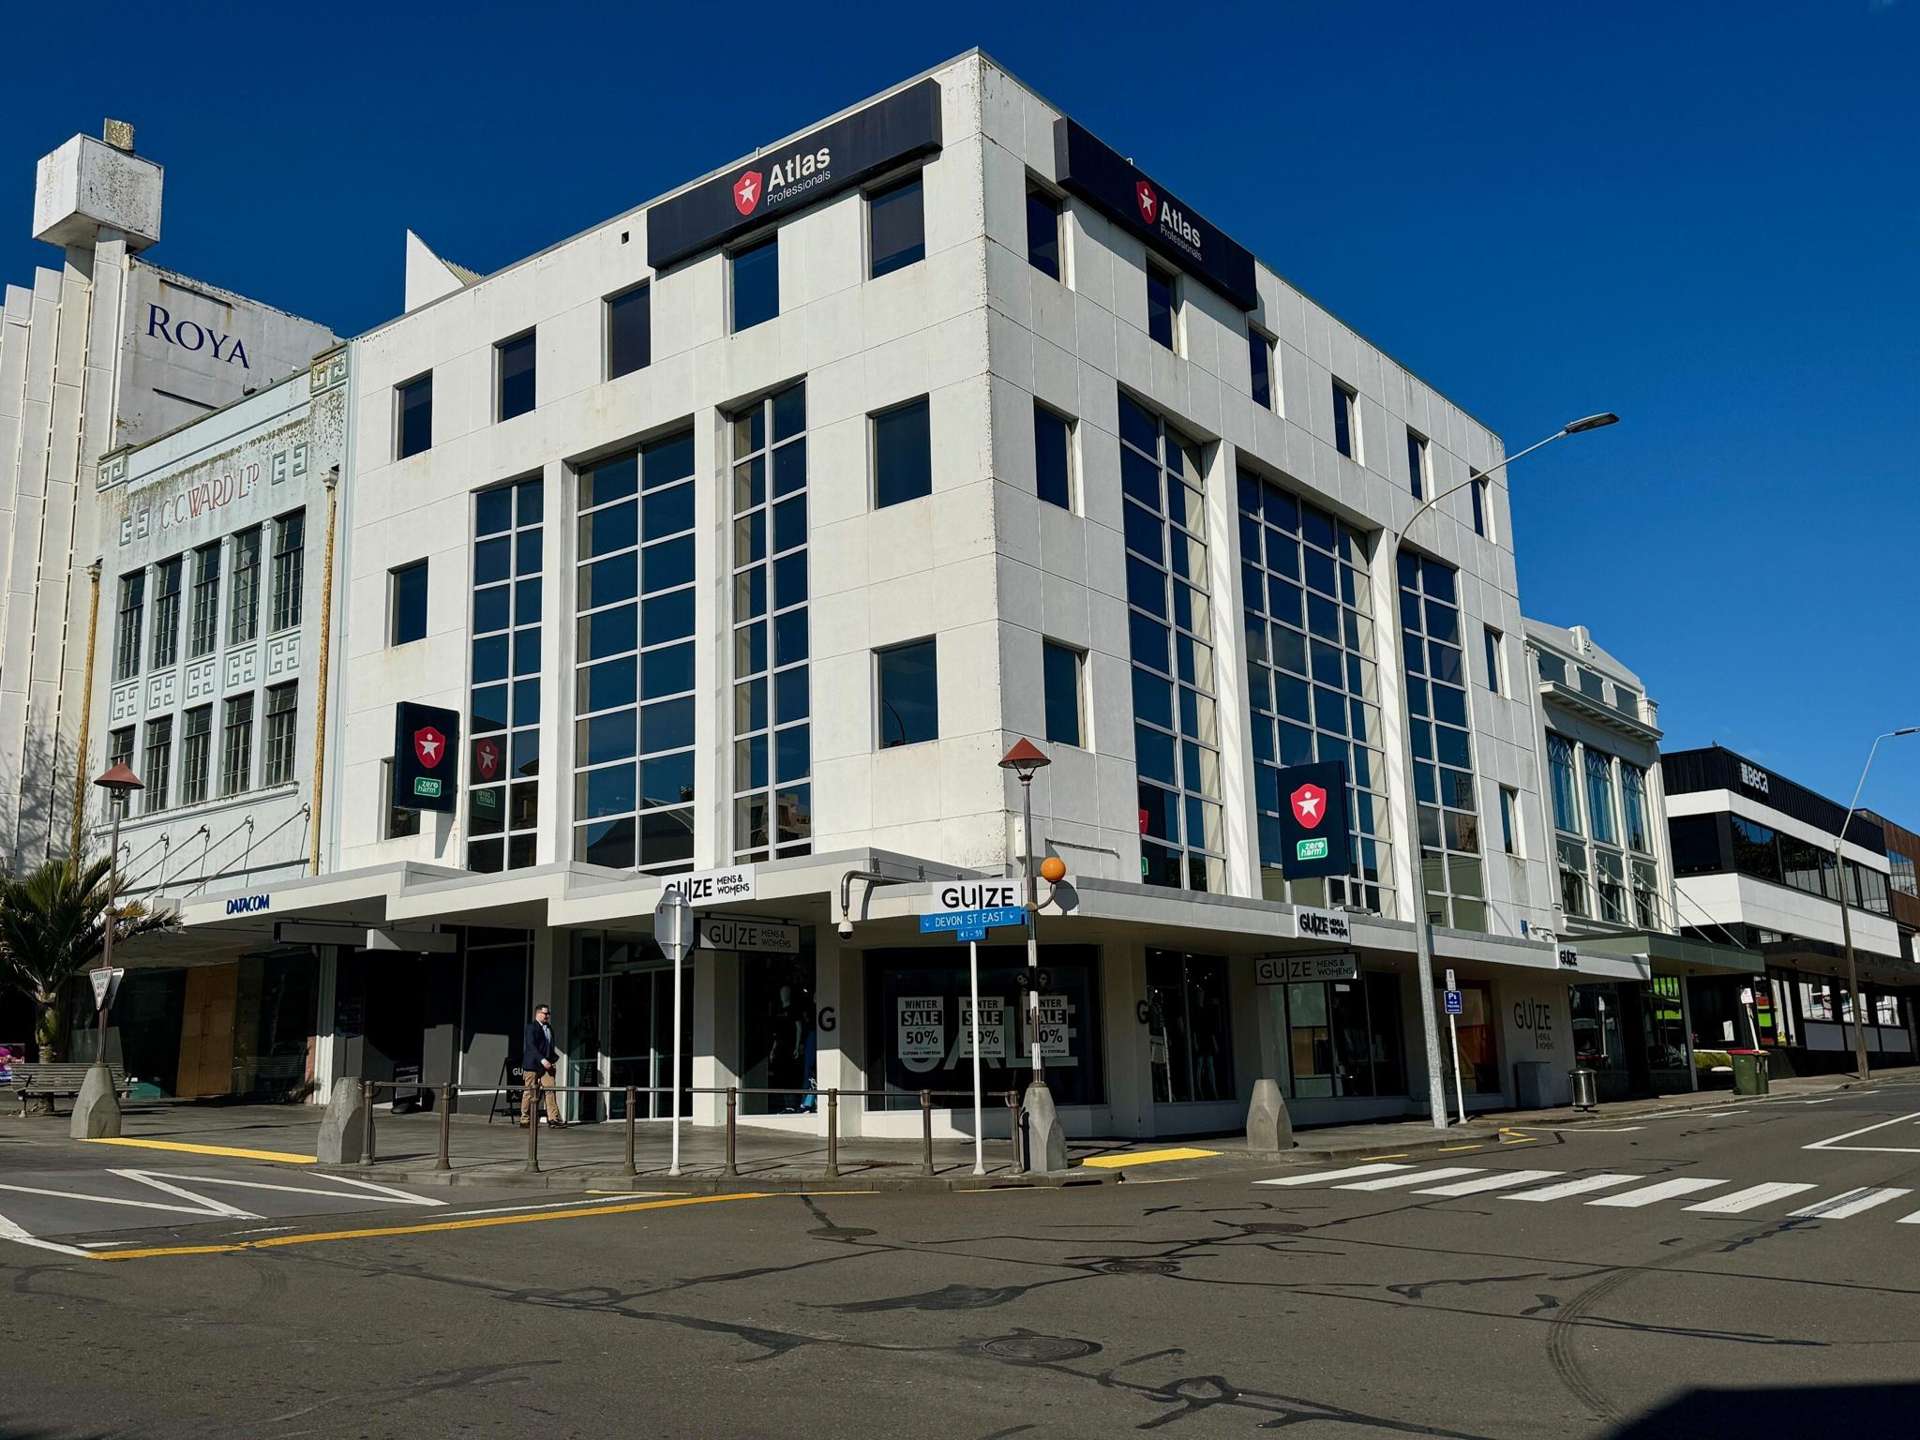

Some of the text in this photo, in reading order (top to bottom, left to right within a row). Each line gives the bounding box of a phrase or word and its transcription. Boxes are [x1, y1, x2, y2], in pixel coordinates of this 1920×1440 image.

[768, 147, 831, 192] Atlas
[767, 170, 831, 206] Professionals
[1160, 201, 1200, 248] Atlas
[146, 302, 250, 370] ROYA
[418, 785, 436, 793] harm
[422, 780, 439, 788] zero
[1301, 848, 1322, 856] harm
[1305, 842, 1325, 850] zero
[716, 875, 736, 886] MENS
[717, 883, 750, 896] WOMENS
[942, 884, 1014, 909] GUIZE
[226, 894, 270, 914] DATACOM
[935, 911, 1004, 928] DEVON ST EAST
[709, 922, 758, 950] GUIZE
[1260, 958, 1312, 982] GUIZE
[904, 1000, 938, 1009] WINTER
[966, 1000, 998, 1009] WNTER
[1040, 999, 1062, 1008] NTER
[818, 1006, 836, 1032] G
[904, 1011, 939, 1025] SALE
[1029, 1010, 1063, 1024] ALE
[1514, 997, 1552, 1049] GUIZE
[906, 1030, 938, 1045] 50%
[1039, 1029, 1063, 1044] 0%
